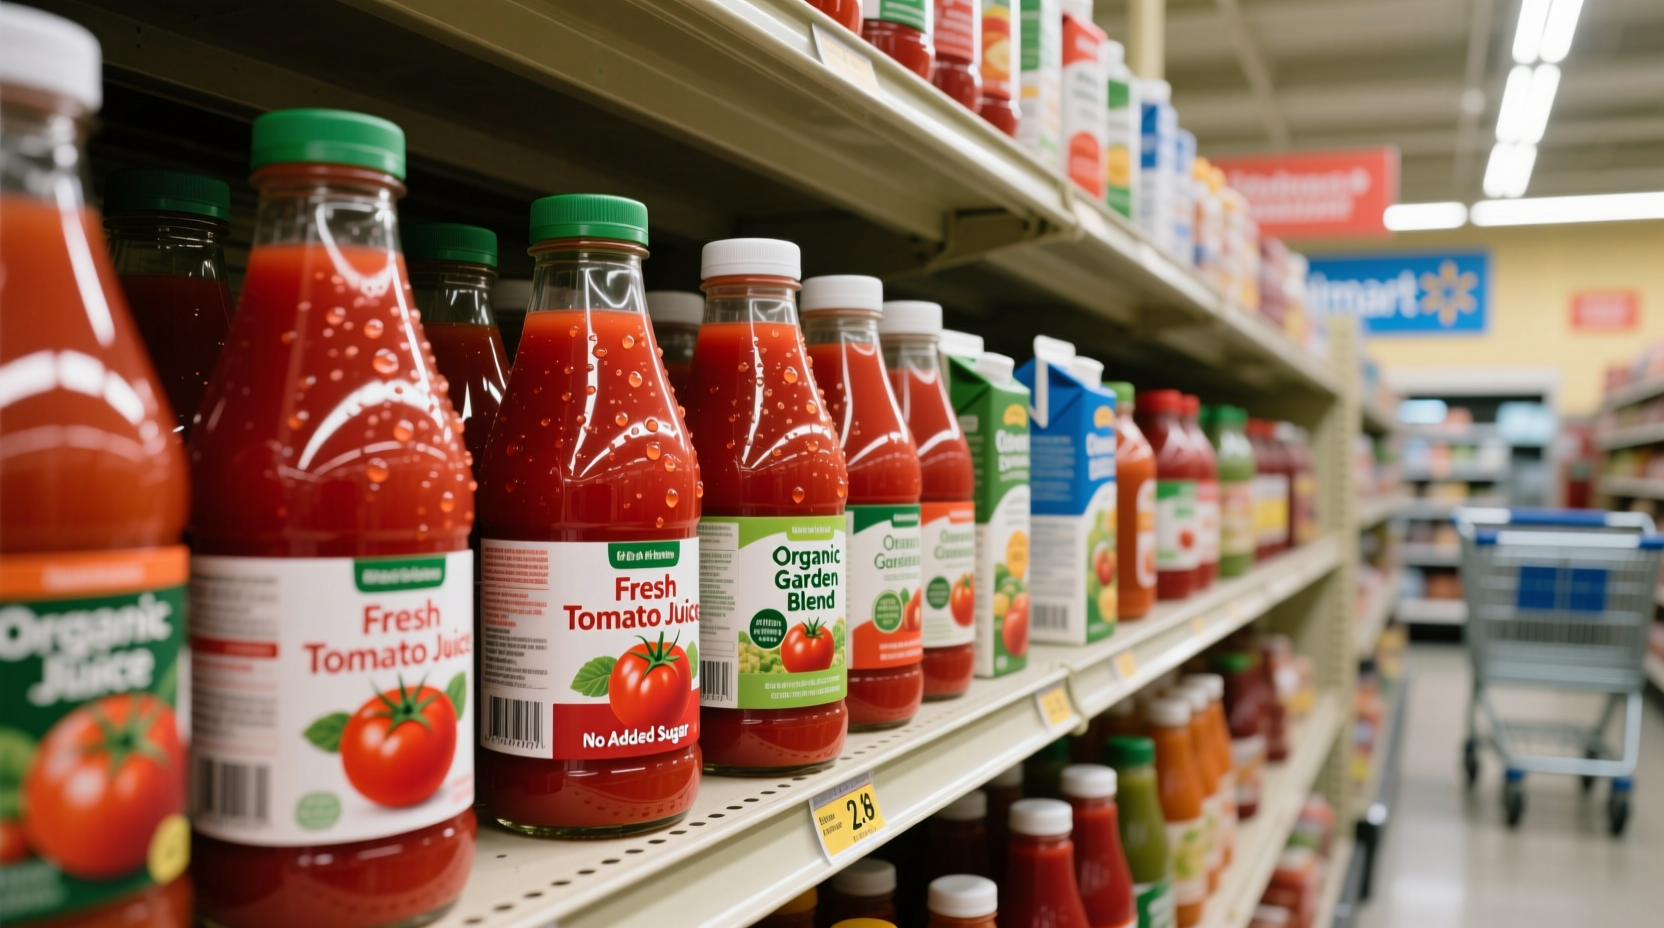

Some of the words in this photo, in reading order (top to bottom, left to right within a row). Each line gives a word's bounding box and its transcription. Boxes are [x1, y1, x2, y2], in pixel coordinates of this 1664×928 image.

[1304, 268, 1419, 319] lmart
[772, 543, 841, 571] Organic
[615, 573, 677, 601] Fresh
[774, 567, 838, 590] Garden
[787, 589, 835, 611] Blend
[362, 599, 440, 635] Fresh
[563, 604, 661, 631] Tomato
[303, 640, 427, 675] Tomato
[26, 647, 156, 707] Juice
[583, 731, 605, 749] No
[607, 725, 655, 747] Added
[657, 723, 689, 744] Sugar
